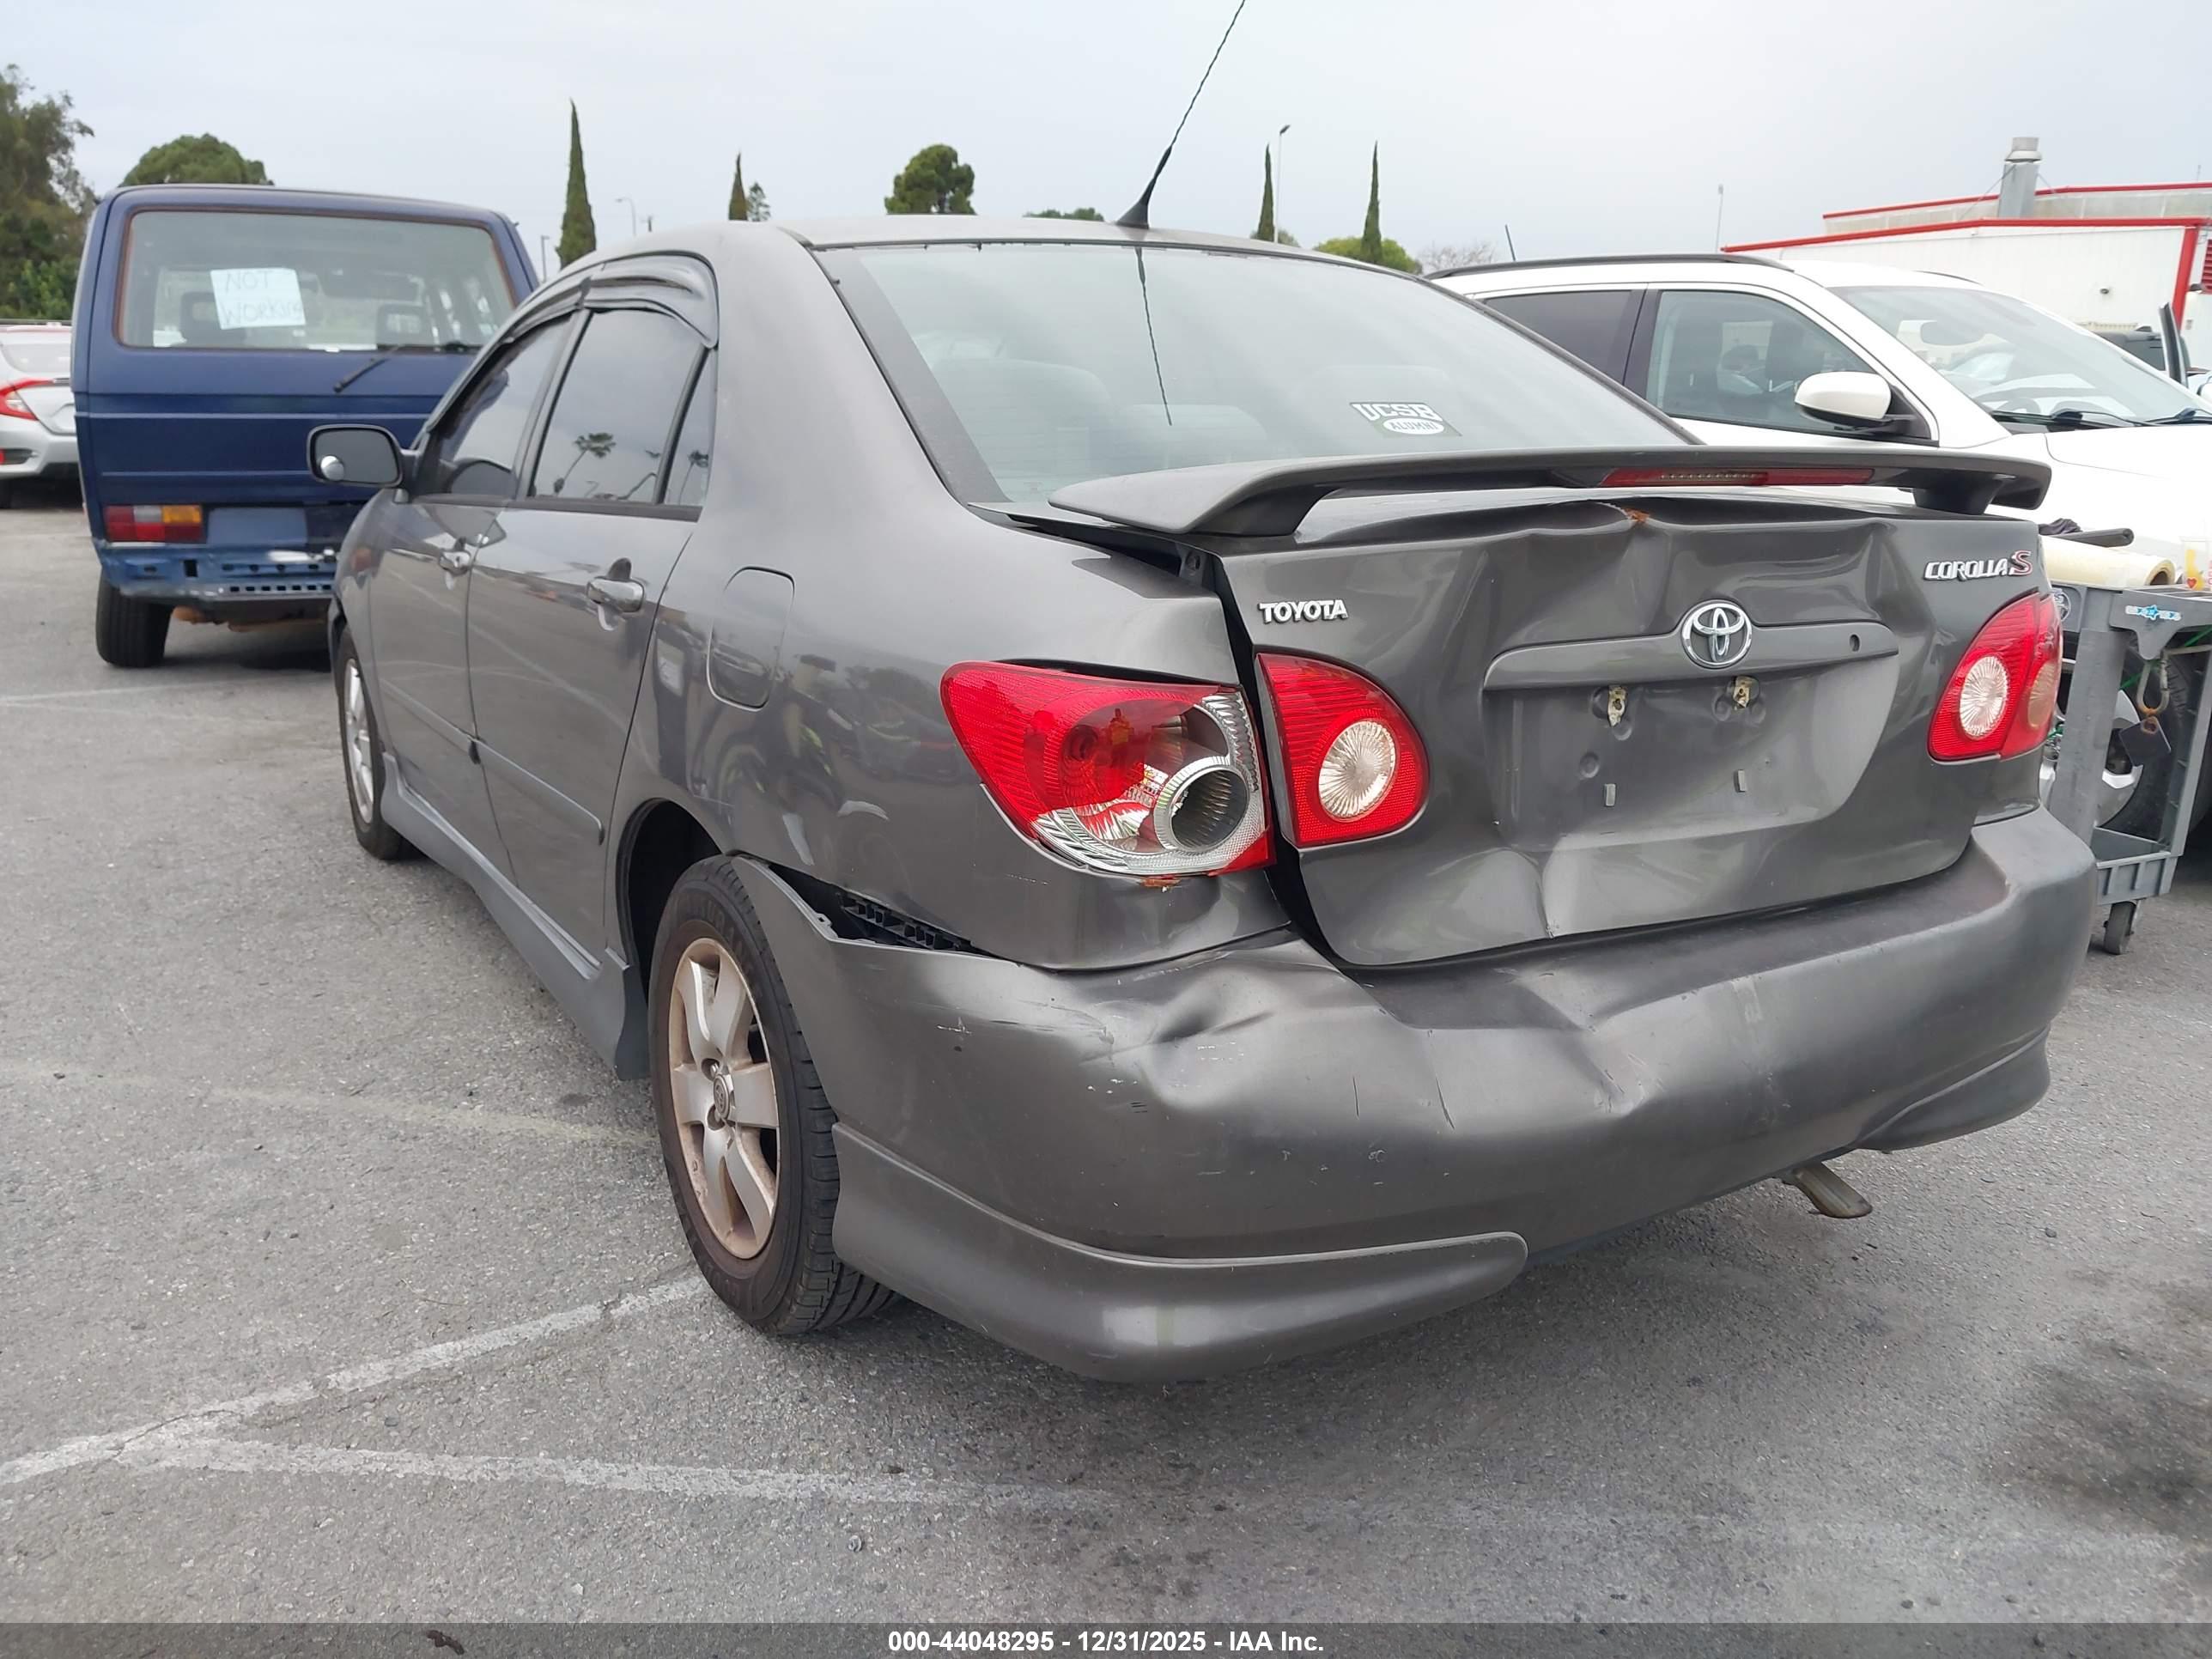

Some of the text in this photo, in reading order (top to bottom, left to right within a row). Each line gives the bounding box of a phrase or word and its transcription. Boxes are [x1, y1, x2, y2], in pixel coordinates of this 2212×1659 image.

[226, 270, 275, 293] NOT
[1351, 404, 1443, 422] UCSB
[1389, 422, 1439, 430] ALUMNI
[1923, 558, 2008, 581] COROLLA
[1258, 599, 1349, 624] TOYOTA
